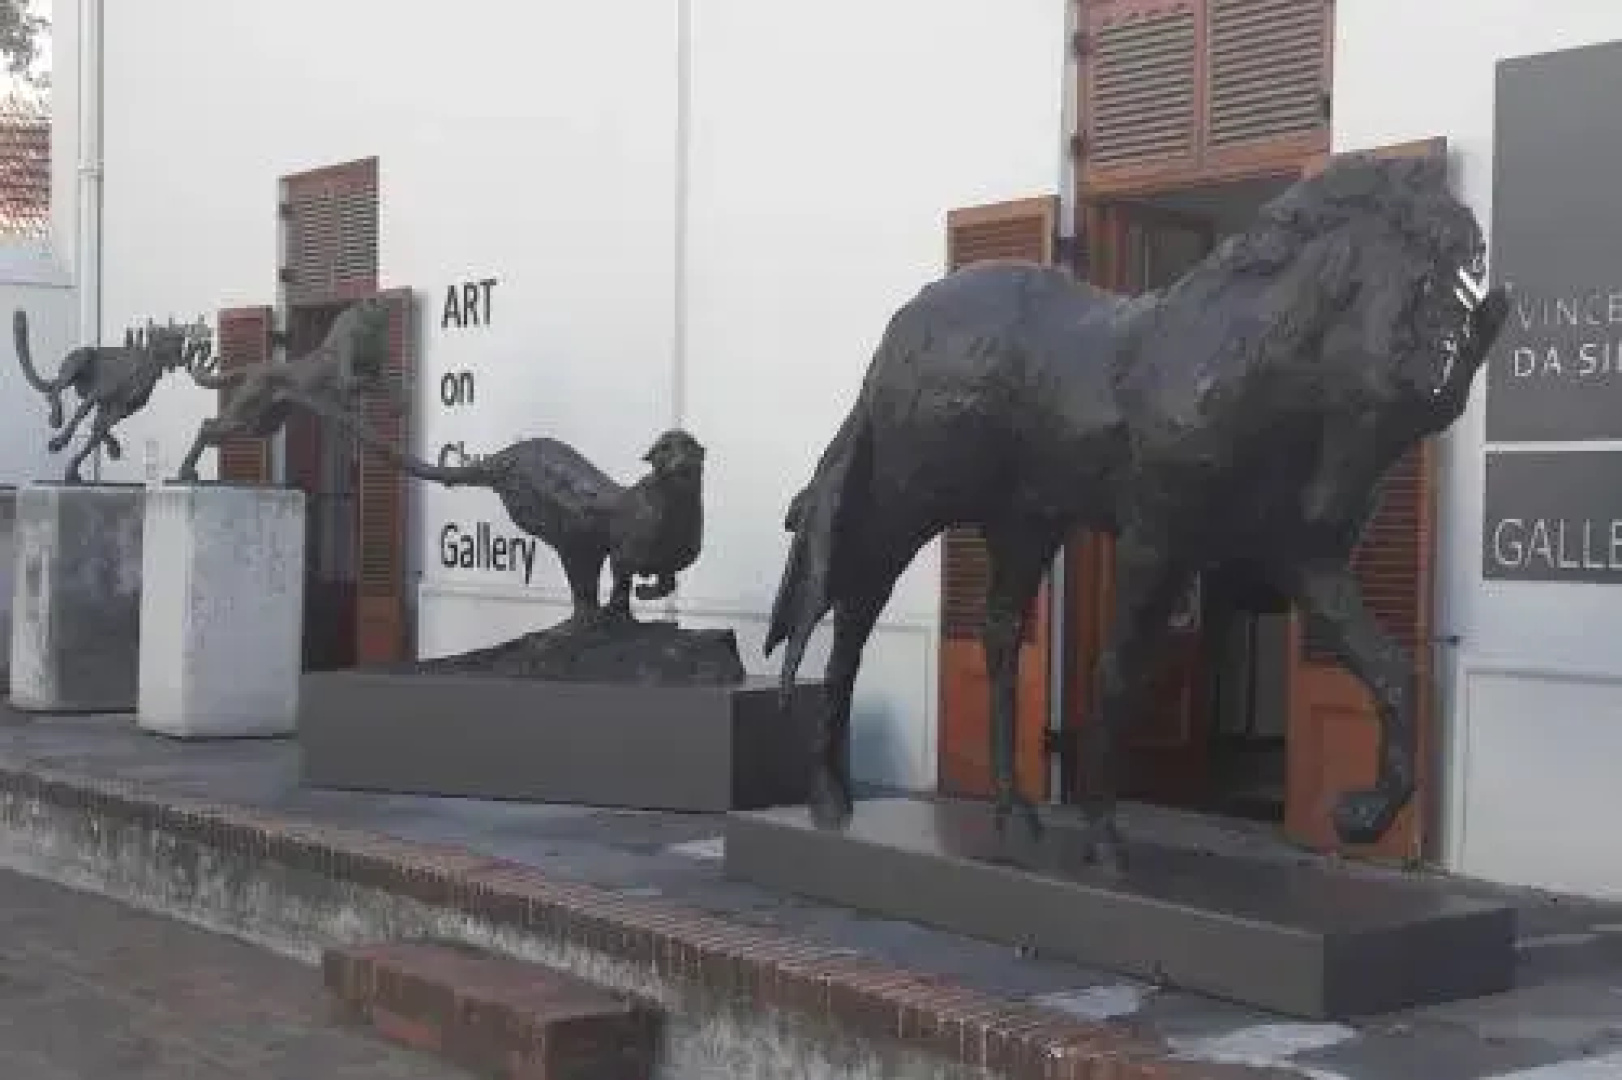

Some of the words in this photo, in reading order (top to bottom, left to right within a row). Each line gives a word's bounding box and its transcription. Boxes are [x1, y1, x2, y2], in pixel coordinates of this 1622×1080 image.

[441, 278, 497, 329] ART
[1514, 346, 1561, 377] DA
[1579, 343, 1622, 374] SI
[440, 370, 475, 407] on
[440, 521, 536, 585] Gallery
[1495, 518, 1622, 569] GALLE
